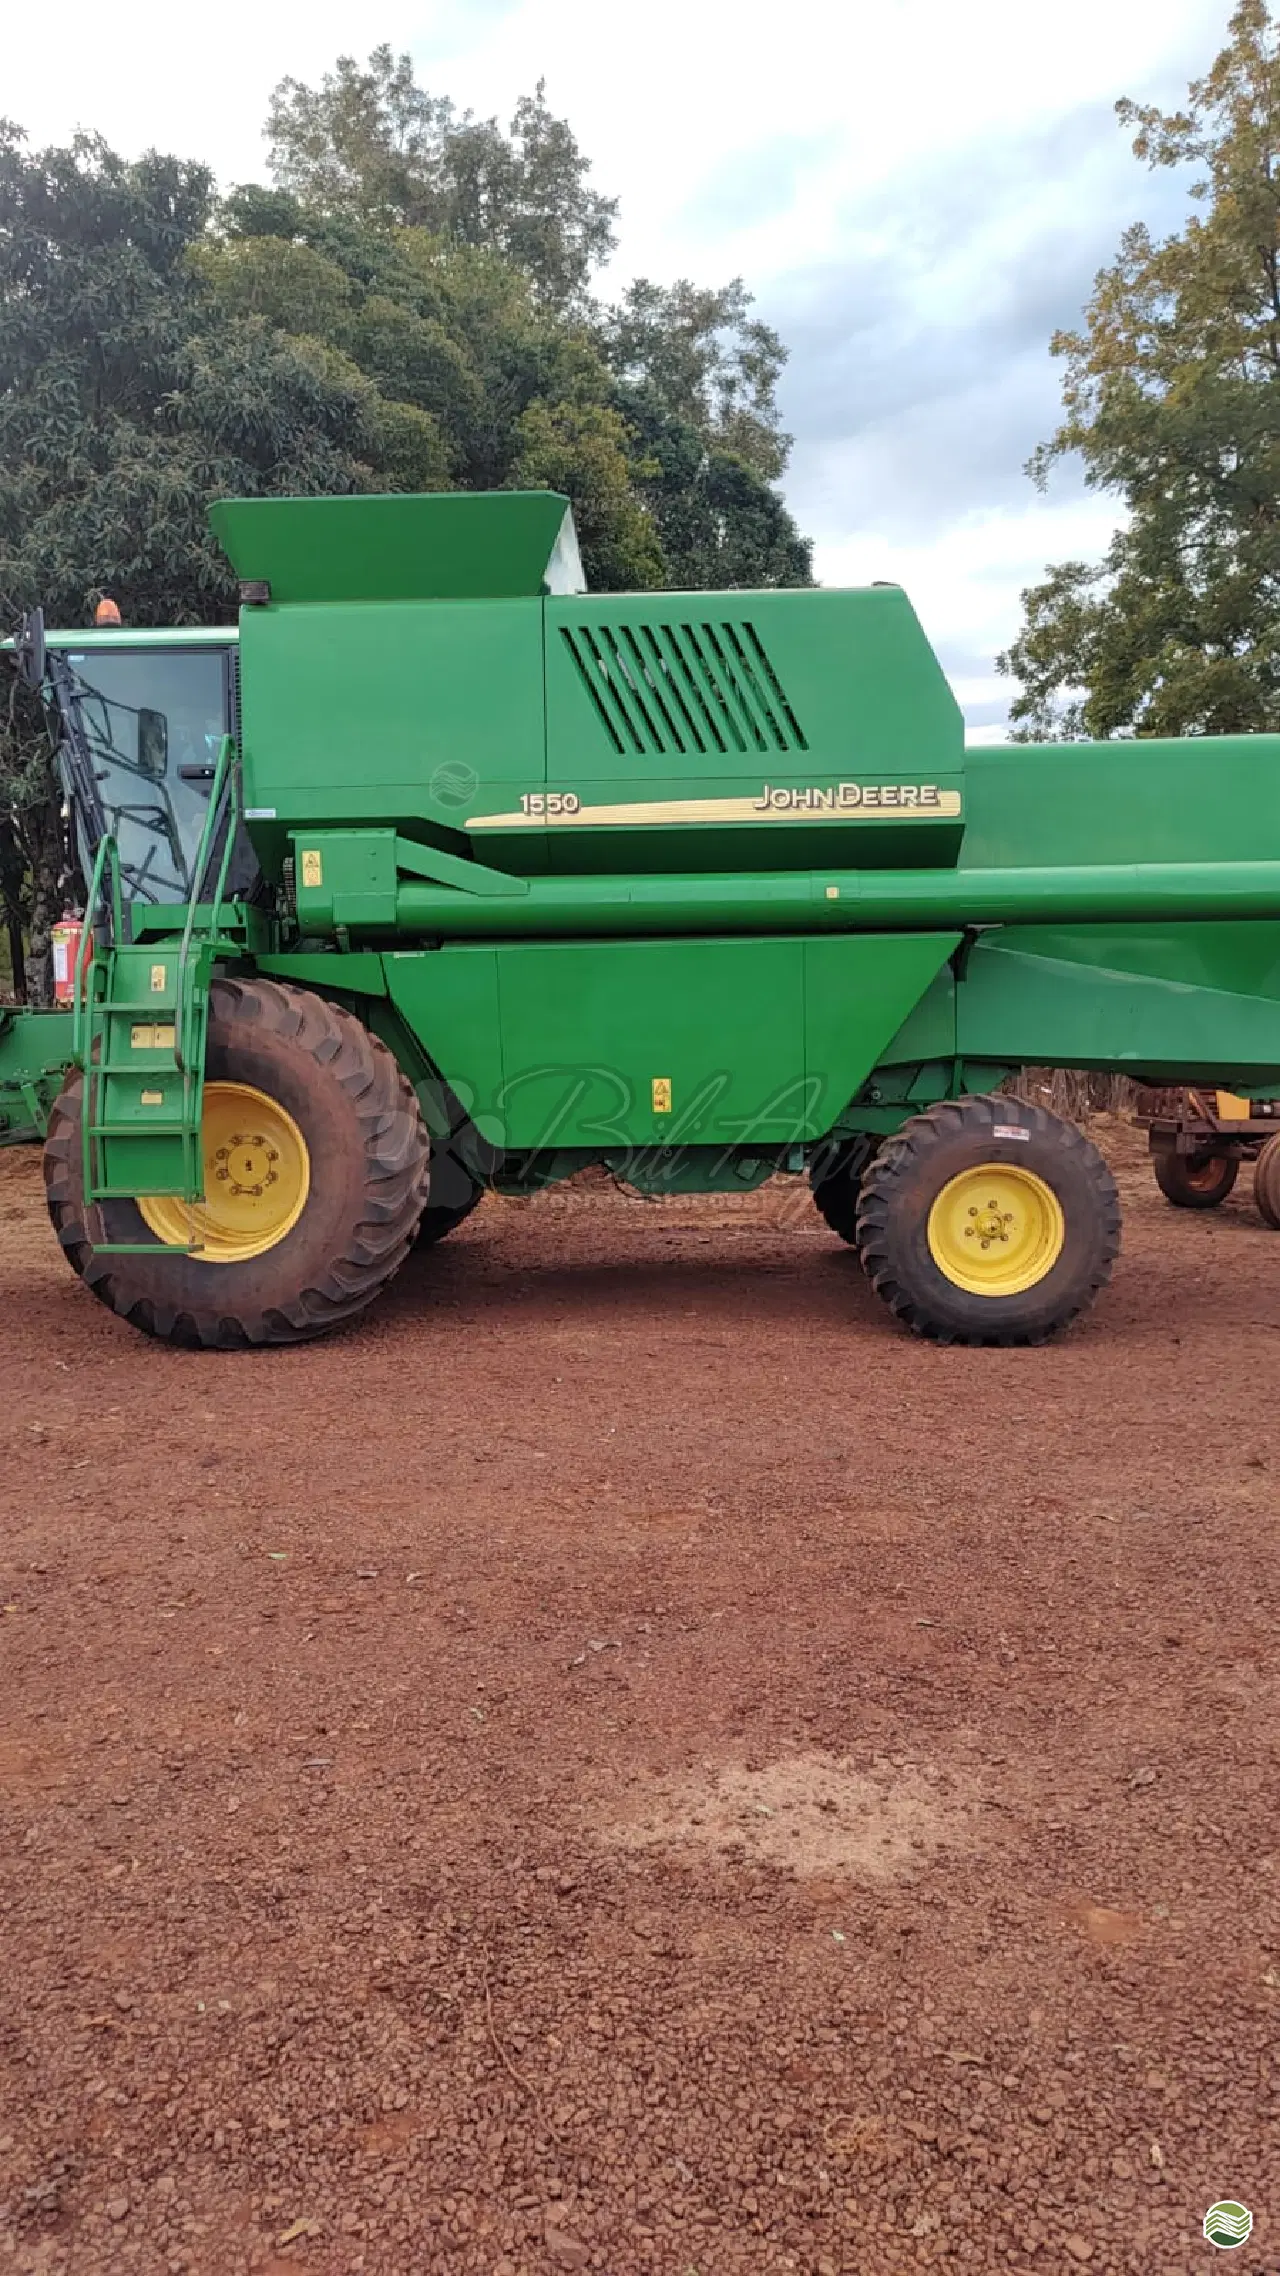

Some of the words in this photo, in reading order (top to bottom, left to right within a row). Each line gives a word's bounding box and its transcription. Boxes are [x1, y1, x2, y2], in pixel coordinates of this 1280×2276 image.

[519, 793, 580, 815] 1550
[753, 784, 836, 811] JOHN
[839, 782, 942, 808] DEERE
